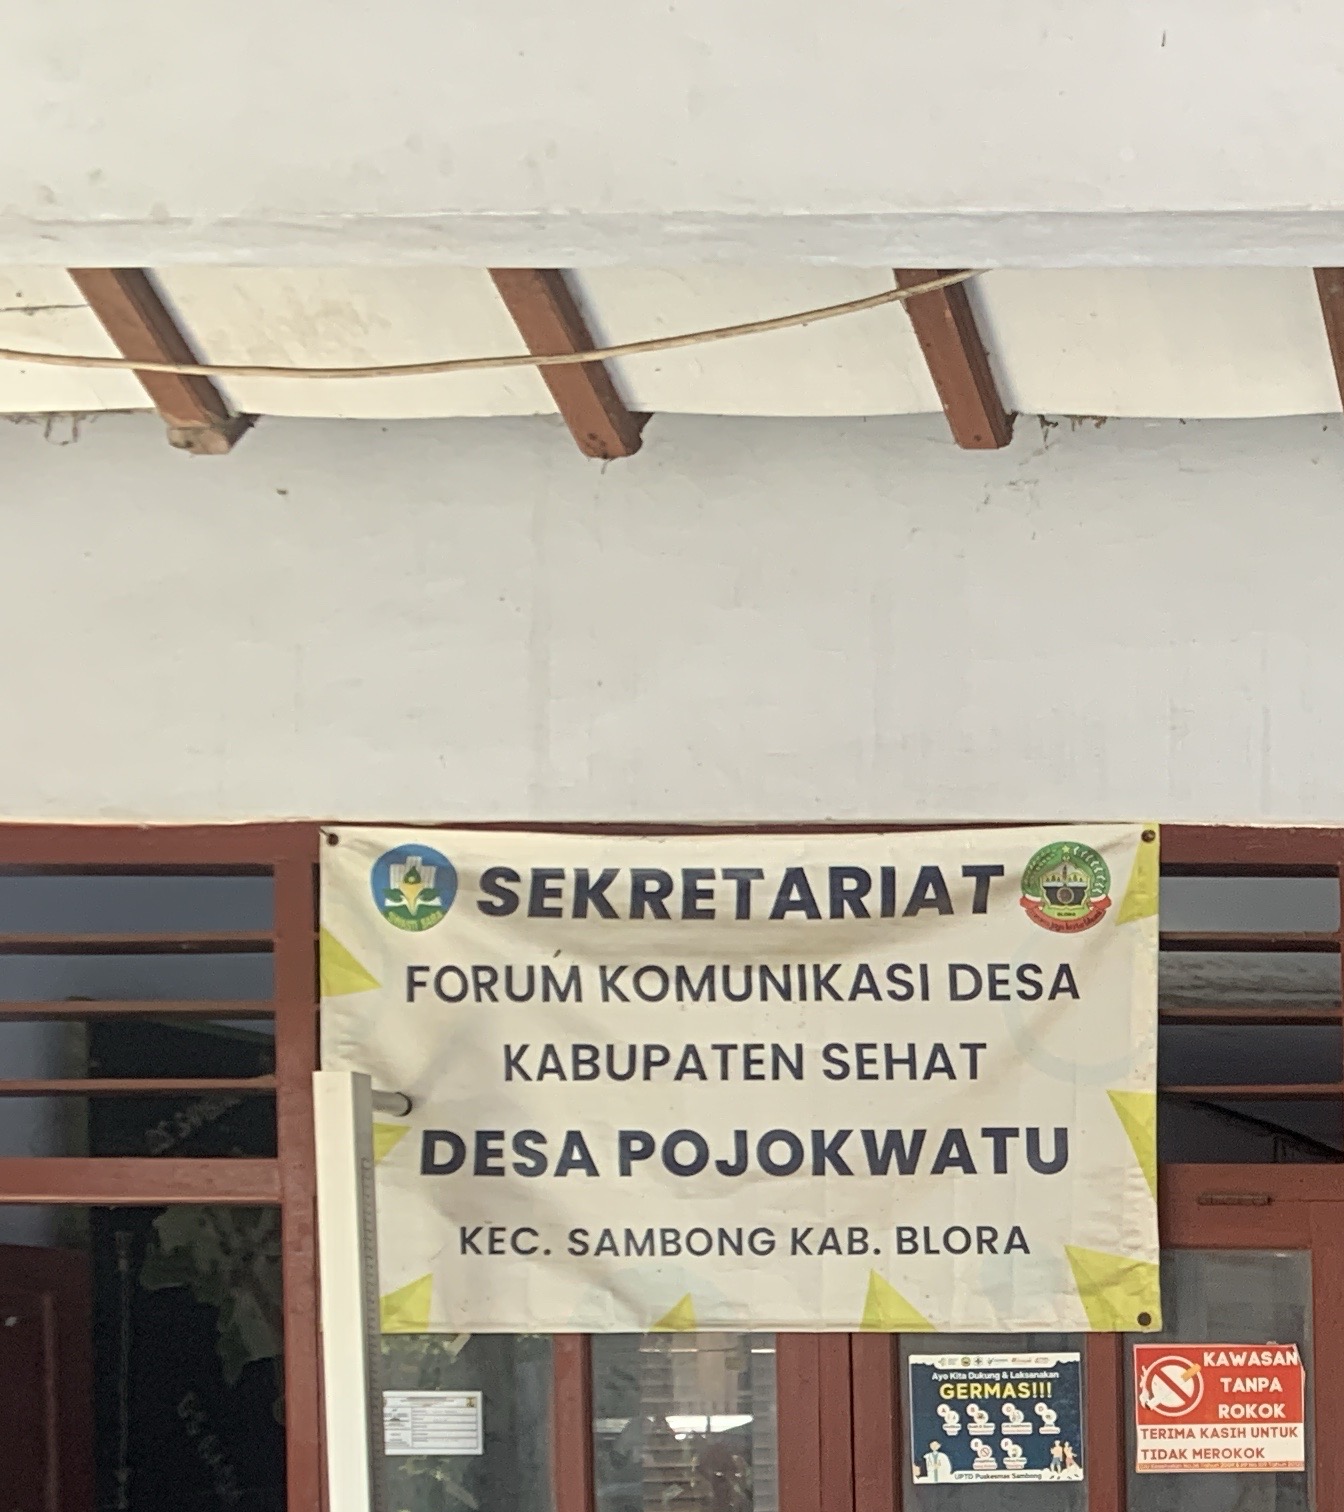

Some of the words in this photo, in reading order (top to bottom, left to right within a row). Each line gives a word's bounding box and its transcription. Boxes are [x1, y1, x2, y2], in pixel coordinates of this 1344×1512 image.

[476, 863, 1005, 921] SEKRETARIAT
[405, 964, 583, 1004] FORUM
[600, 962, 929, 1003] KOMUNIKASI
[948, 962, 1081, 1002] DESA
[503, 1044, 804, 1082] KABUPATEN
[822, 1042, 988, 1080] SEHAT
[420, 1129, 599, 1177] DESA
[620, 1126, 1070, 1176] POJOKWATU
[460, 1227, 551, 1256] KEC.
[568, 1227, 776, 1256] SAMBONG
[790, 1226, 881, 1256] KAB.
[896, 1225, 1030, 1256] BLORA
[1204, 1351, 1298, 1367] KAWASAN
[932, 1372, 949, 1381] Ayo
[950, 1372, 967, 1380] Kita
[968, 1372, 1001, 1381] Dukung
[1010, 1371, 1060, 1379] Laksanakan
[939, 1382, 1053, 1400] GERMAS!!!
[1220, 1378, 1283, 1393] TANPA
[1218, 1404, 1286, 1419] ROKOK
[1140, 1428, 1196, 1440] TERIMA
[1200, 1427, 1247, 1439] KASIH
[1251, 1427, 1298, 1439] UNTUK
[1141, 1449, 1187, 1460] TIDAK
[1192, 1448, 1265, 1460] MEROKOK
